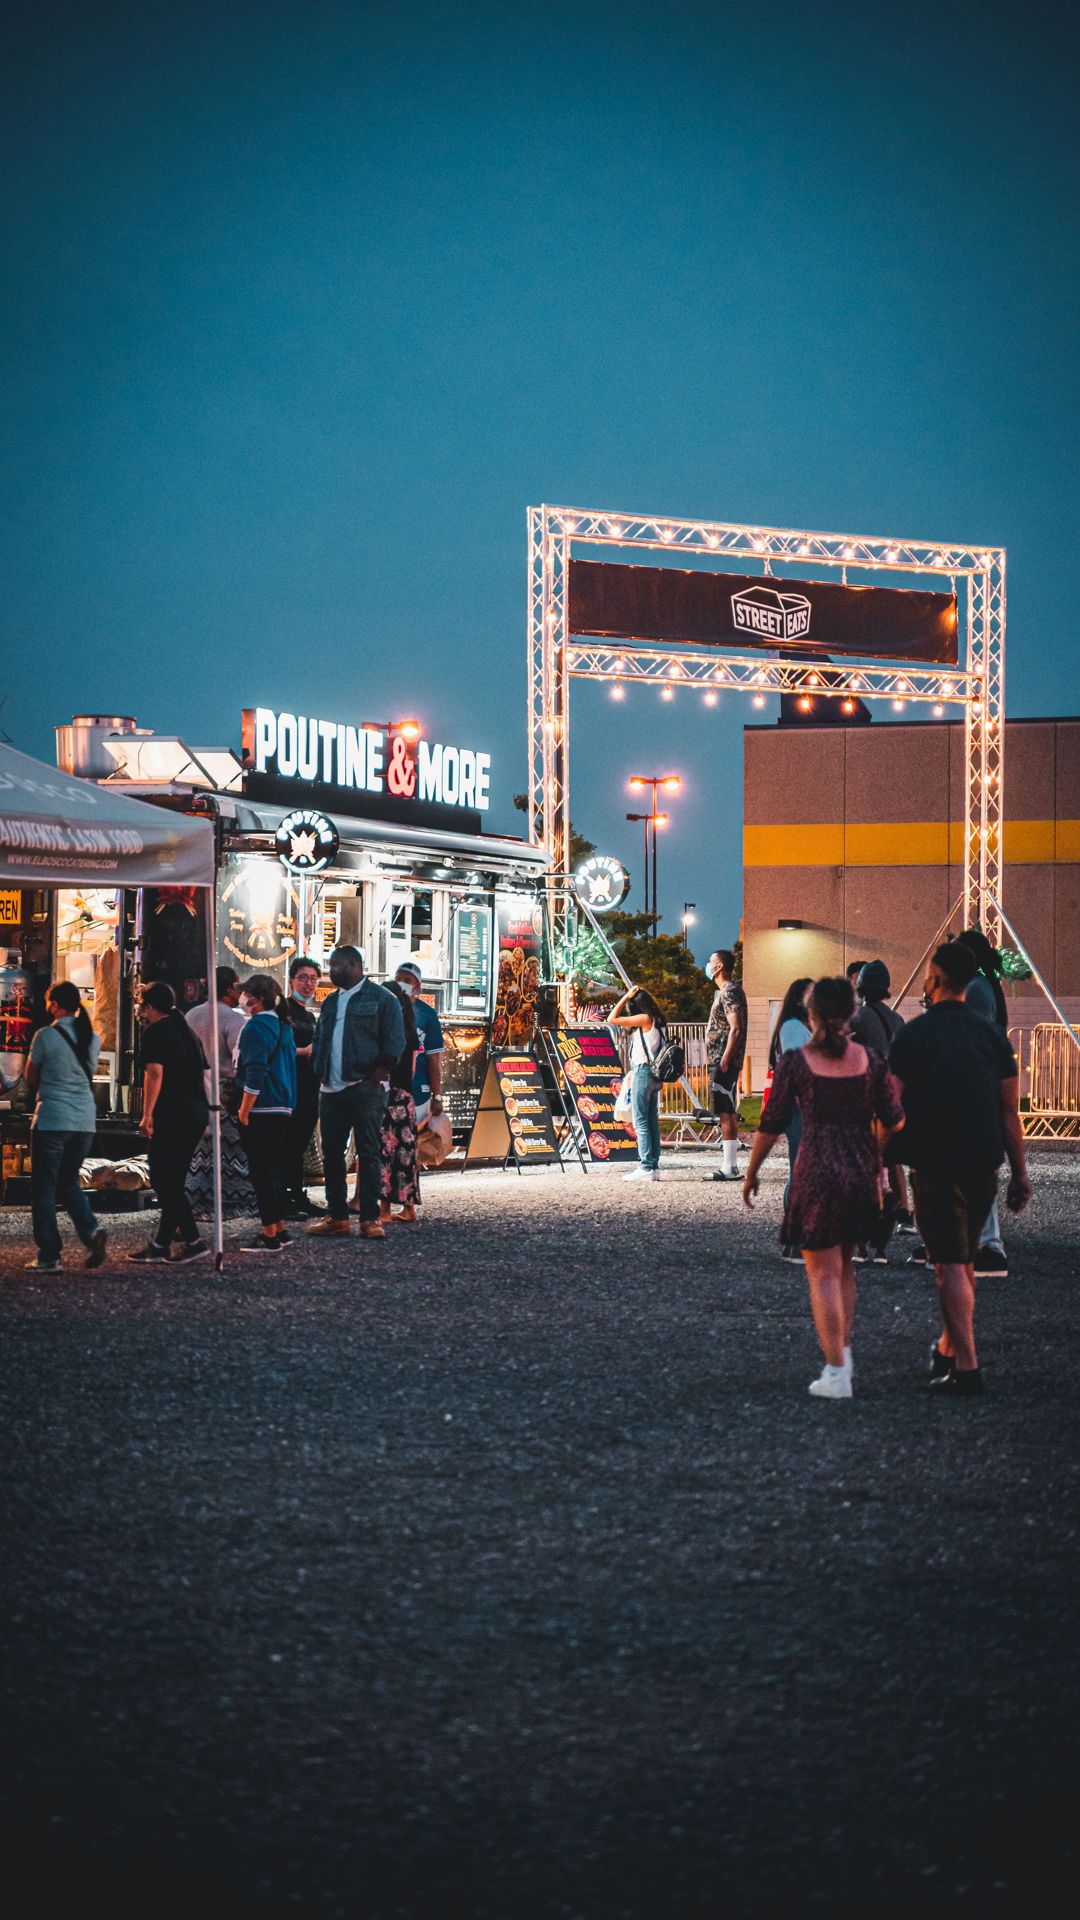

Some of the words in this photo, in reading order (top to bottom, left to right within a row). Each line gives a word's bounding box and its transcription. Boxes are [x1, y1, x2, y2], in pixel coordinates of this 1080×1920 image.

[736, 603, 782, 635] STREET
[787, 610, 808, 636] EATS
[254, 708, 384, 792] POUTINE
[387, 736, 416, 797] &
[418, 740, 491, 810] MORE
[0, 819, 69, 851] AUTHENTIC
[67, 828, 111, 853] LATIN
[108, 829, 144, 854] FOOD
[276, 810, 333, 843] POUTINE
[575, 856, 624, 885] POUTINE
